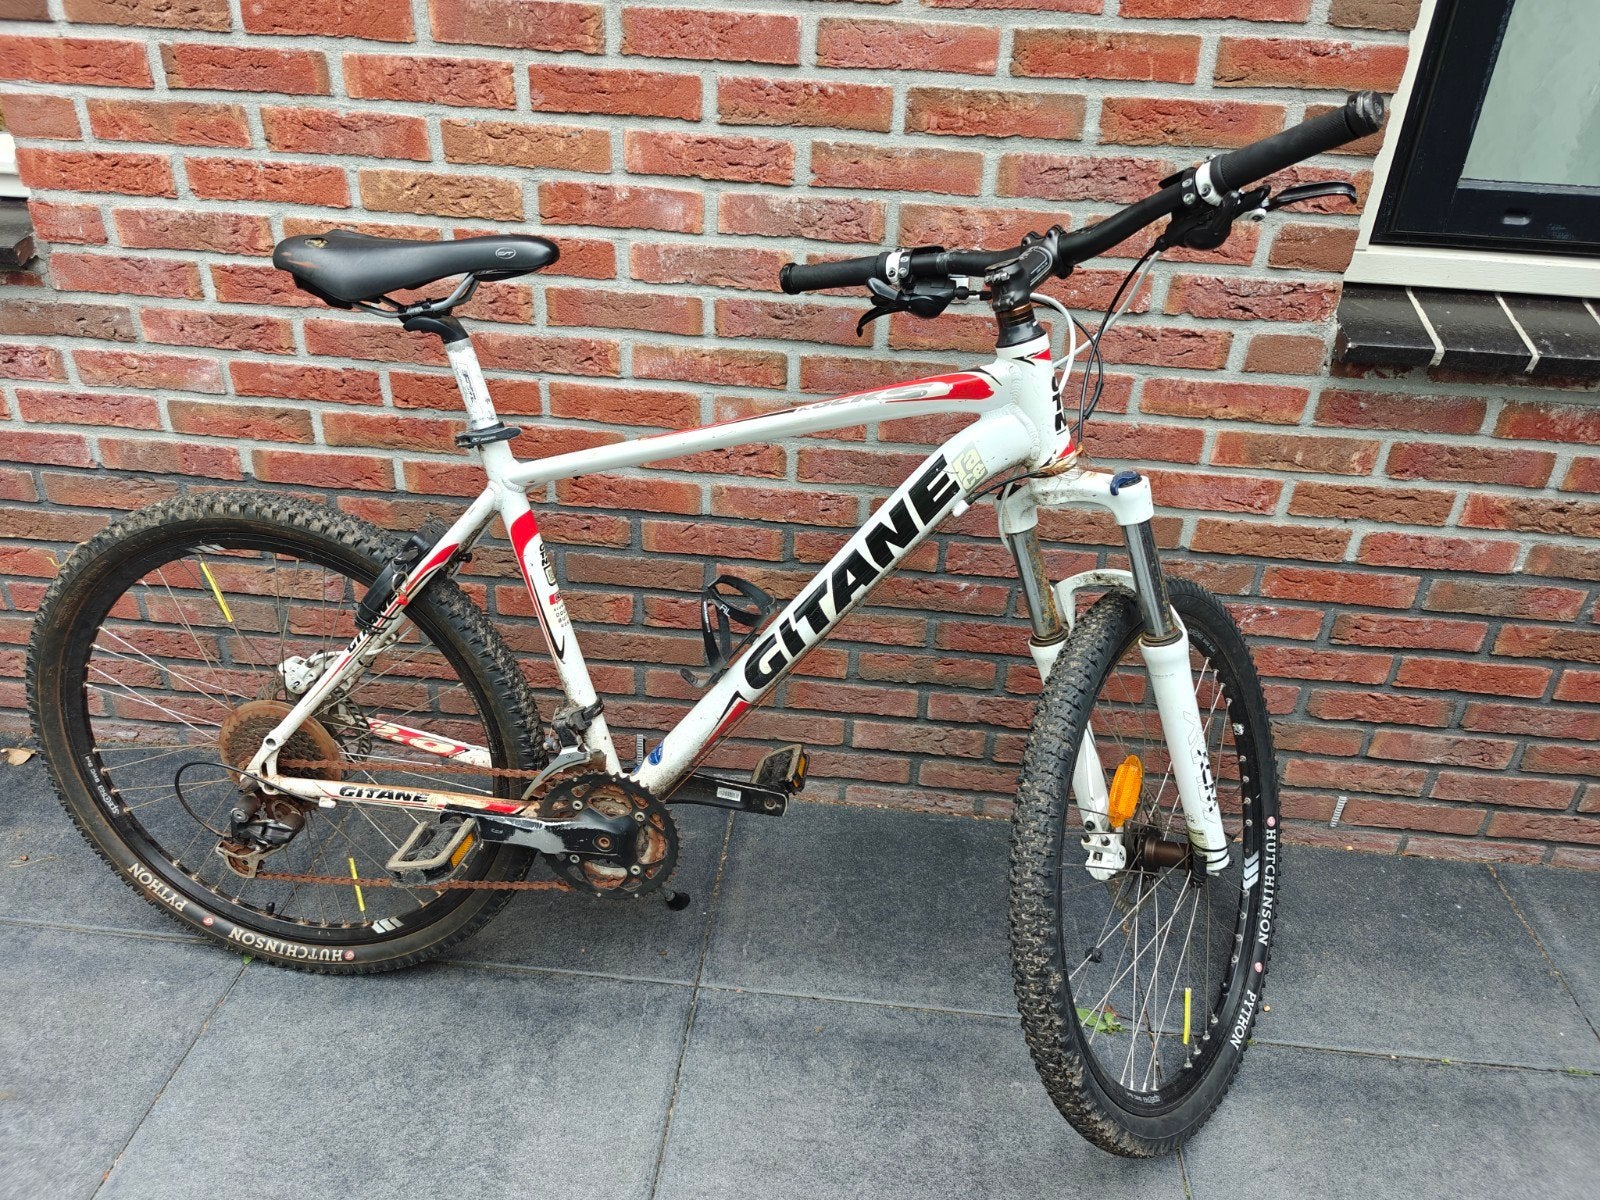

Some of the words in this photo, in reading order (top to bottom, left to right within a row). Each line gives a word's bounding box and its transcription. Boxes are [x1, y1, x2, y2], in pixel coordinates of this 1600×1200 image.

[744, 454, 961, 690] GITANE
[338, 785, 430, 803] GITANE
[129, 862, 189, 911] PYTHON
[1259, 828, 1277, 945] HUTCHINSON
[229, 927, 343, 962] HUTCHINSON
[1231, 988, 1257, 1050] PYTHON
